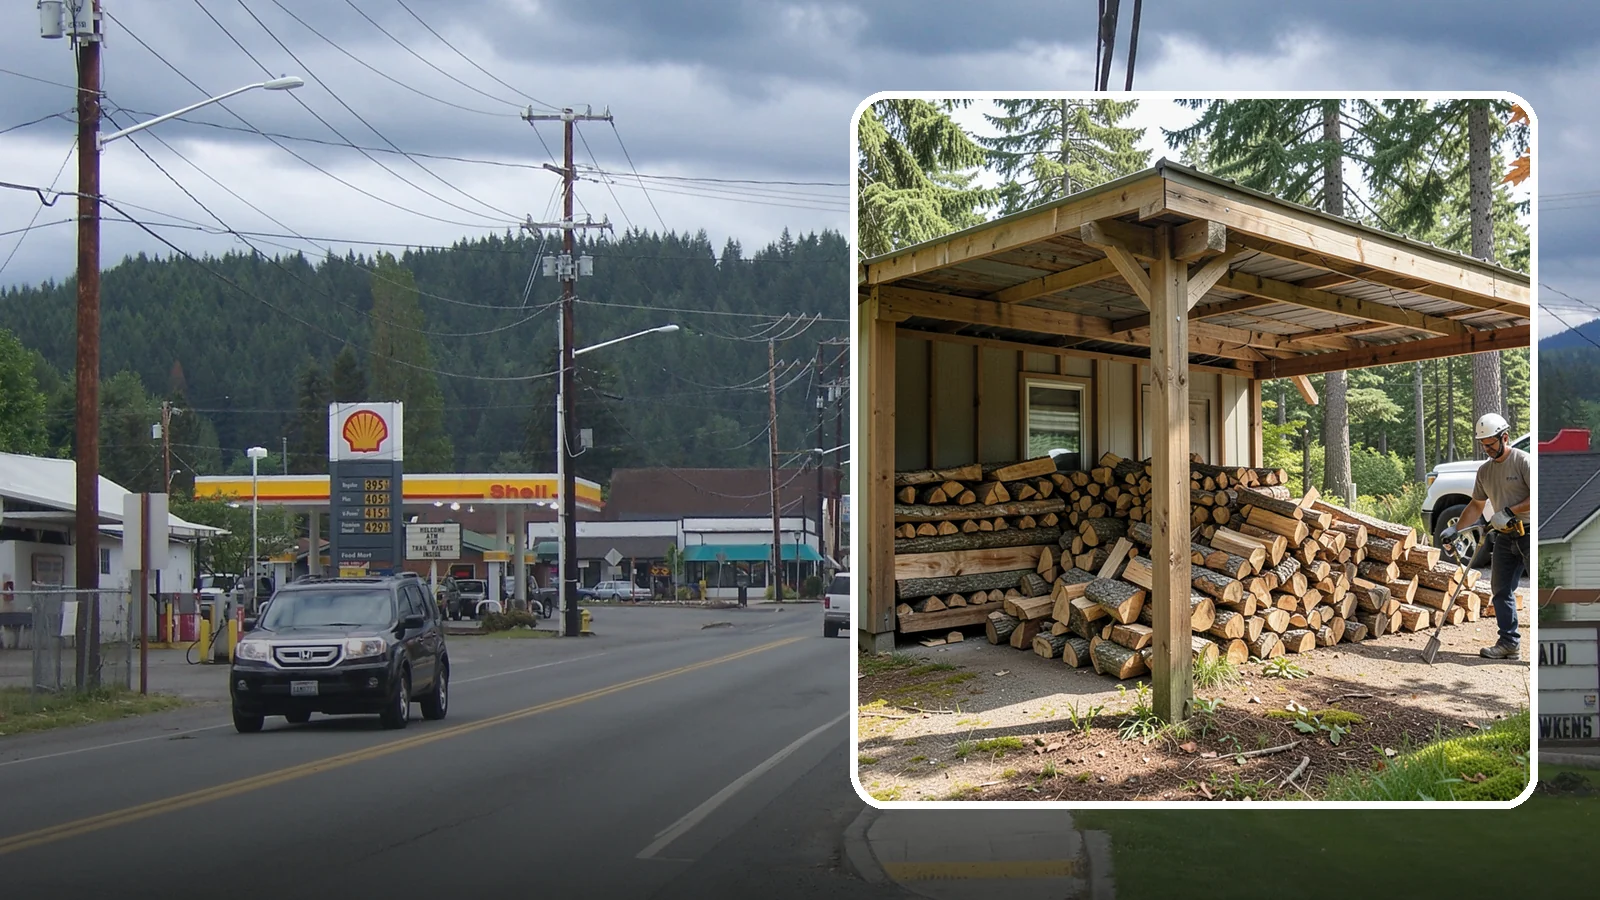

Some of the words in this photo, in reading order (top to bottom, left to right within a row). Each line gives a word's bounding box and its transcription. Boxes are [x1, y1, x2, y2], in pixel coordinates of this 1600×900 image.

[365, 480, 384, 490] 395
[490, 484, 547, 499] Shell
[365, 494, 384, 504] 405
[365, 508, 384, 518] 415
[365, 522, 384, 532] 429
